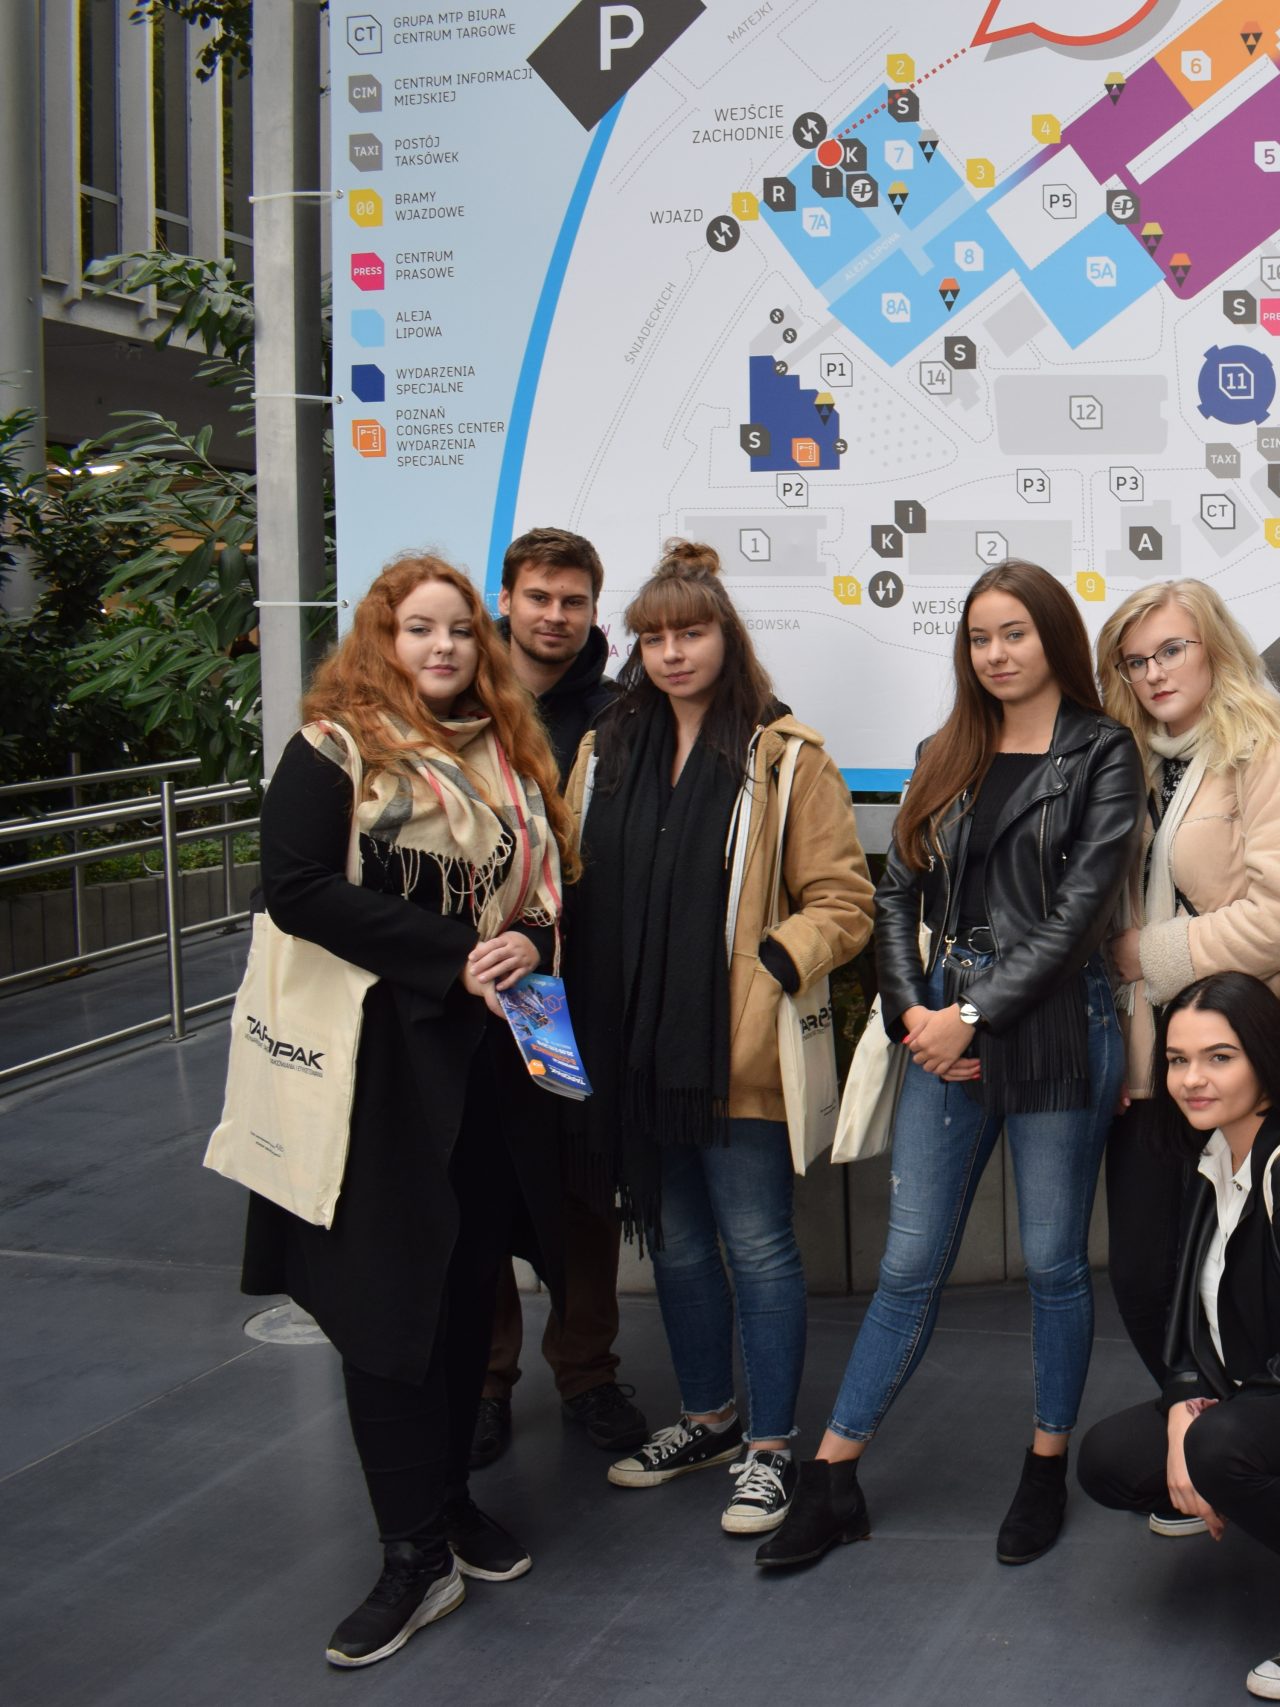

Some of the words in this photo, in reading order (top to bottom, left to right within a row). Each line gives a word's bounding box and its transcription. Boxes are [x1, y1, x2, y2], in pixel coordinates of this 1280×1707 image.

[393, 15, 434, 29] GRUPA
[439, 12, 464, 24] MTP
[468, 8, 506, 21] BIURA
[727, 4, 773, 44] MATEJKI
[354, 26, 375, 42] CT
[394, 28, 452, 45] CENTRUM
[457, 24, 516, 40] TARGOWE
[600, 4, 644, 71] P
[895, 60, 905, 75] 2
[1190, 58, 1202, 74] 6
[394, 74, 452, 90] CENTRUM
[457, 68, 533, 84] INFORMACJI
[353, 86, 377, 99] CIM
[394, 91, 456, 106] MIEJSKIEJ
[715, 105, 783, 121] WEJŚCIE
[897, 97, 909, 115] S
[692, 125, 783, 144] ZACHODNIE
[1040, 121, 1050, 136] 4
[395, 135, 440, 151] POSTÓJ
[354, 145, 379, 157] TAXI
[846, 147, 858, 163] K
[893, 147, 905, 163] 7
[1264, 149, 1275, 165] 5
[395, 151, 458, 167] TAKSÓWEK
[976, 165, 985, 180] 3
[395, 192, 436, 205] BRAMY
[773, 186, 785, 202] R
[1050, 194, 1072, 208] P5
[355, 202, 374, 216] 00
[395, 206, 465, 221] WJAZDOWE
[741, 199, 750, 213] 1
[650, 209, 703, 224] WJAZD
[809, 214, 828, 230] 7A
[395, 251, 453, 265] CENTRUM
[964, 250, 974, 265] 8
[354, 267, 382, 276] PRESS
[396, 267, 454, 280] PRASOWE
[1090, 263, 1114, 279] 5A
[886, 299, 908, 314] 8A
[1233, 299, 1246, 315] S
[396, 311, 432, 322] ALEJA
[624, 281, 676, 365] ŚNIADECKICH
[396, 327, 442, 339] LIPOWA
[954, 344, 966, 361] S
[396, 366, 475, 379] WYDARZENIA
[827, 363, 845, 376] P1
[927, 370, 946, 385] 14
[1227, 373, 1247, 389] 11
[397, 382, 463, 395] SPECJALNE
[396, 406, 445, 420] POZNAŃ
[1076, 404, 1096, 420] 12
[397, 423, 453, 436] CONGRES
[459, 422, 504, 433] CENTER
[397, 438, 475, 452] WYDARZENIA
[749, 432, 761, 448] S
[397, 455, 464, 467] SPECJALNE
[1211, 454, 1237, 464] TAXI
[783, 483, 804, 496] P2
[1024, 478, 1045, 492] P3
[1117, 476, 1138, 490] P3
[1207, 505, 1229, 517] CT
[751, 538, 760, 553] 1
[882, 534, 893, 549] K
[987, 541, 997, 556] 2
[1138, 534, 1153, 551] A
[838, 584, 856, 596] 10
[1085, 579, 1095, 593] 9
